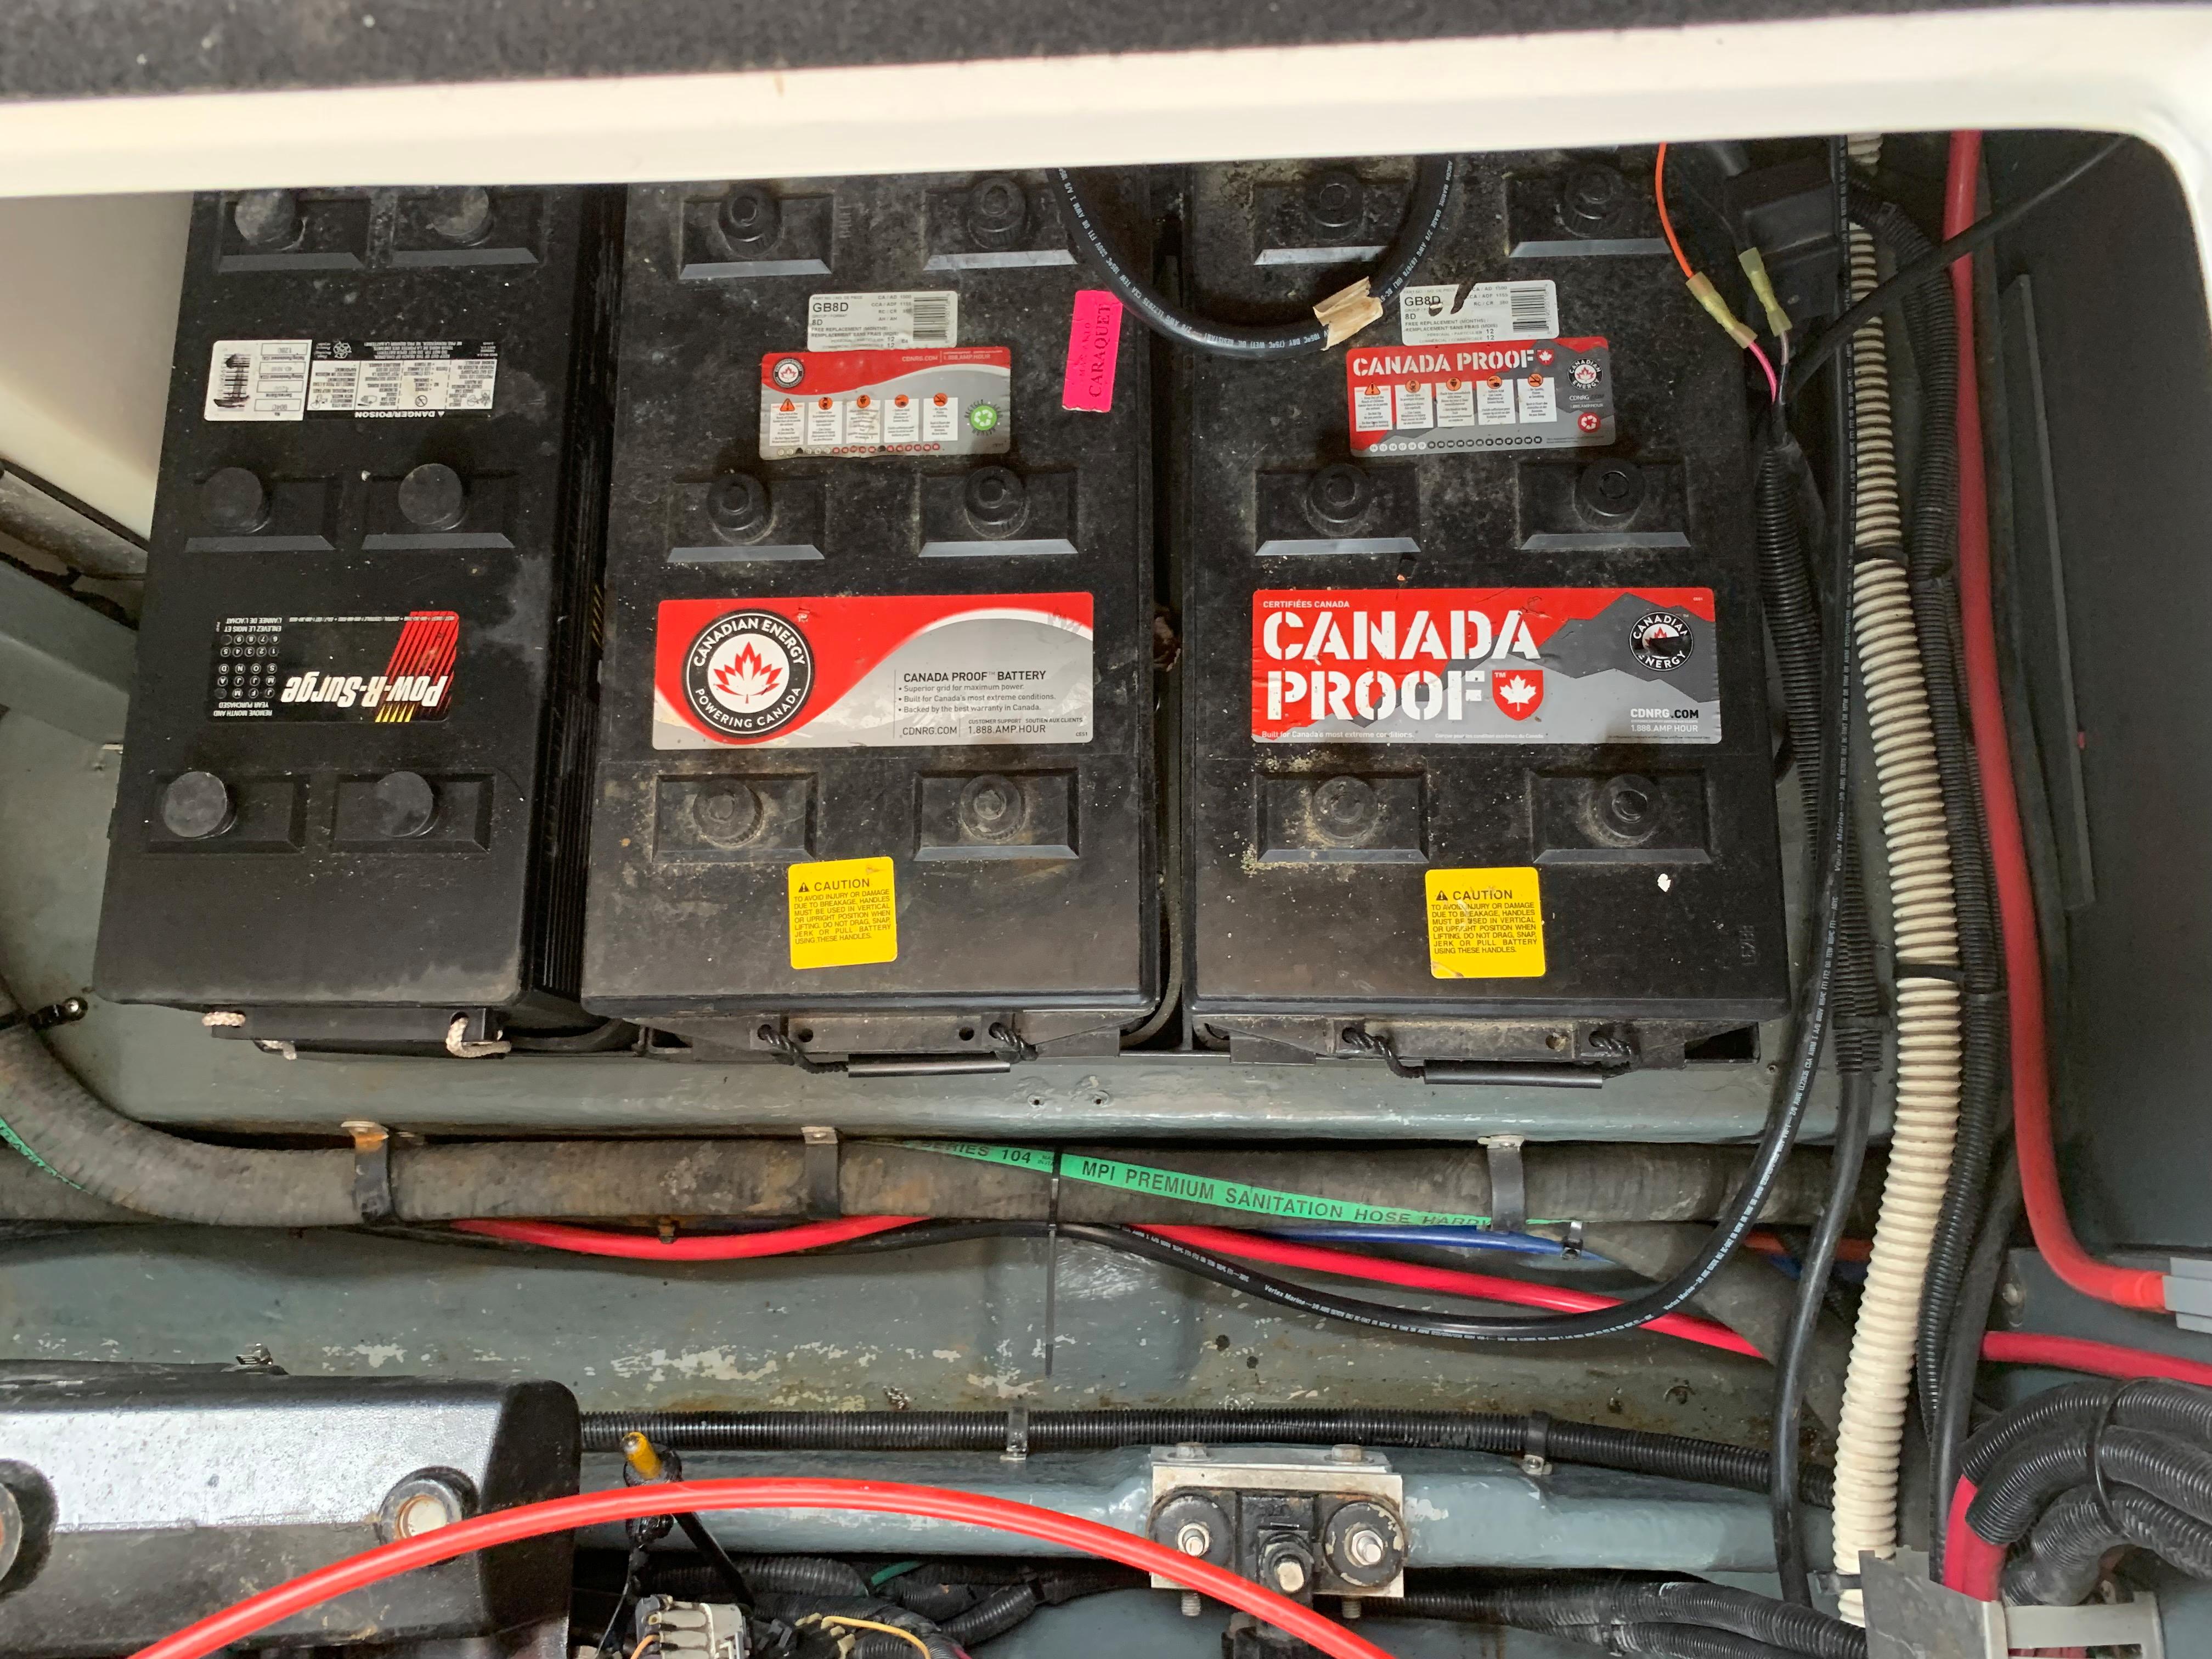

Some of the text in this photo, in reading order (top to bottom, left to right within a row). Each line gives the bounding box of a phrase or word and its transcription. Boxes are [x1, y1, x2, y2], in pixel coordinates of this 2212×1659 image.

[1431, 209, 1441, 229] GRADE
[1119, 274, 1131, 287] TEW
[1131, 286, 1142, 299] CSA
[812, 302, 849, 312] GB8D
[1404, 296, 1441, 306] GB8D
[1088, 303, 1111, 397] CARAQUET
[1353, 349, 1534, 376] CANADA PROOF
[1570, 359, 1601, 373] CANADIAN
[1572, 379, 1599, 389] ENERGY
[1262, 599, 1350, 608] CERTIFIÉES CANADA
[1263, 610, 1541, 660] CANADA
[693, 618, 805, 667] CANADIAN ENERGY
[904, 672, 948, 682] CANADA
[997, 670, 1046, 680] BATTERY
[280, 672, 448, 708] Pow-R-Surge
[904, 685, 935, 693] Superior
[936, 684, 951, 693] grid
[1267, 670, 1485, 720] PROOF
[904, 695, 921, 703] Built
[695, 688, 801, 728] POWERING CANADA
[904, 705, 930, 713] Backed
[931, 705, 940, 714] by
[970, 704, 1003, 713] warranty
[1630, 708, 1699, 718] CDNRG.COM
[902, 726, 957, 735] CDNRG.COM
[814, 878, 870, 891] CAUTION
[1453, 890, 1513, 900] CAUTION
[1001, 1149, 1031, 1164] 104
[1082, 1160, 1115, 1181] MPI
[1125, 1168, 1215, 1200] PREMIUM
[1225, 1187, 1342, 1218] SANITATION
[1354, 1209, 1411, 1223] HOSE
